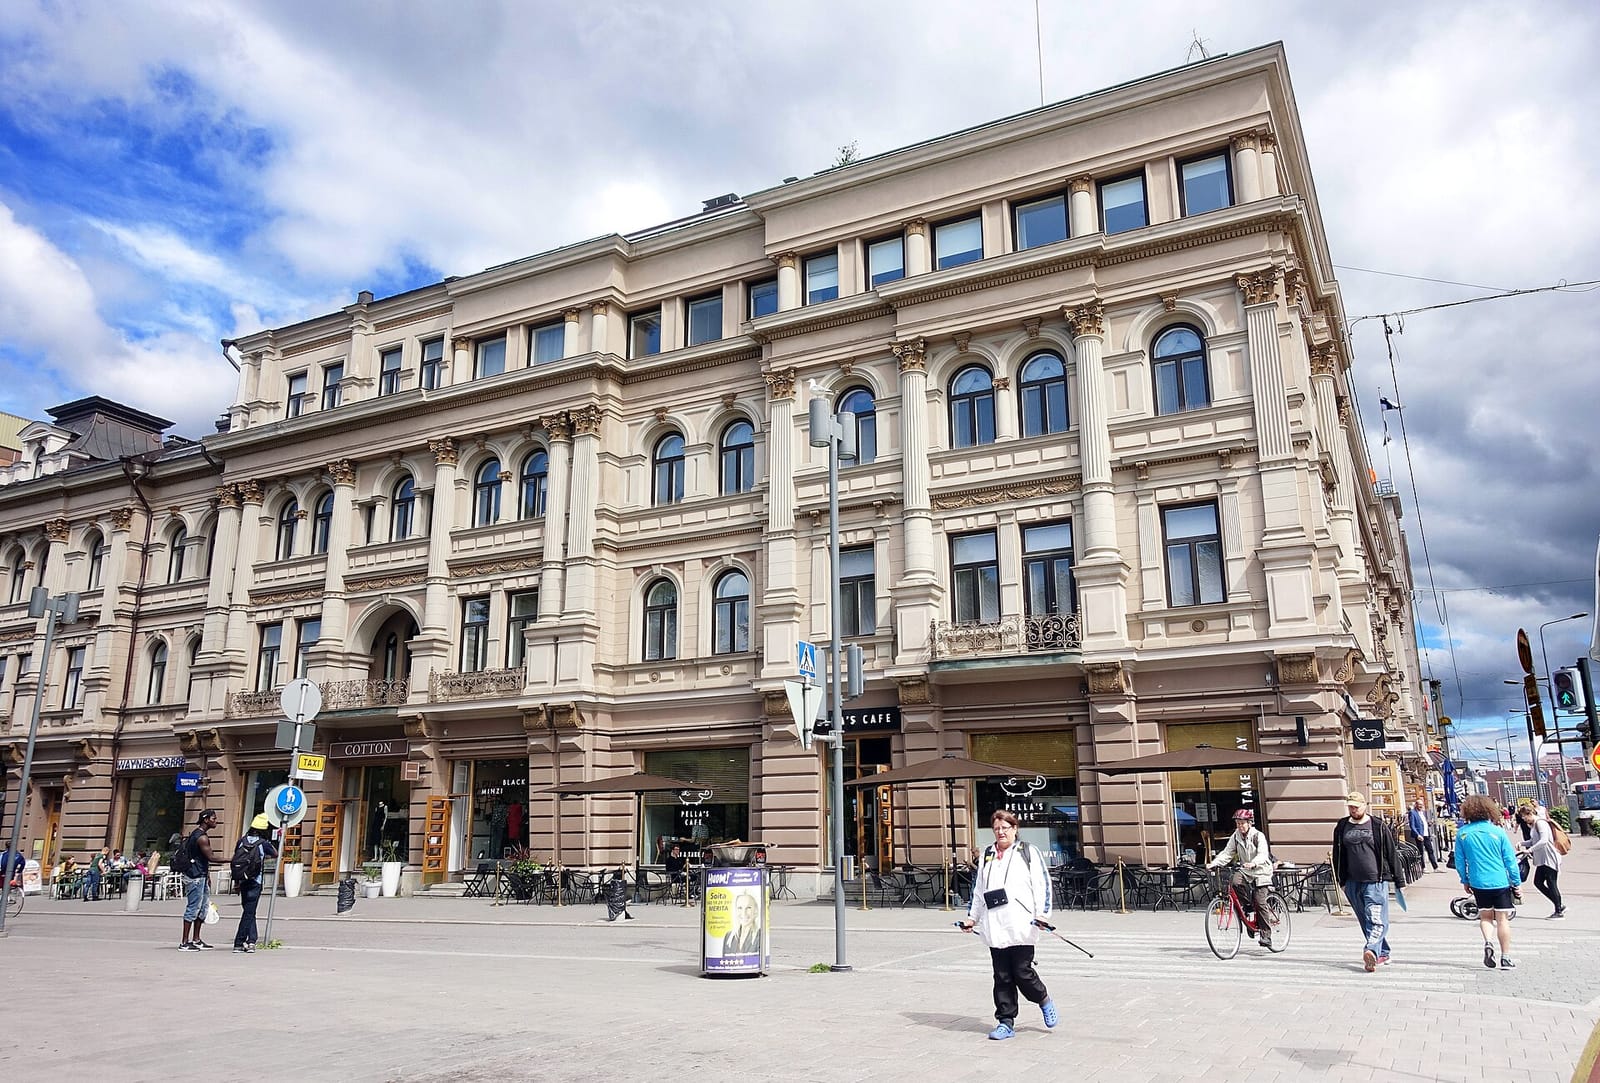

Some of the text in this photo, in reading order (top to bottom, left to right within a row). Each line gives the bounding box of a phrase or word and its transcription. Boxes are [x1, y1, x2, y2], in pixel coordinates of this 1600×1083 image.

[863, 713, 891, 724] CAFE
[1236, 736, 1248, 751] AY
[345, 742, 392, 755] COTTON
[303, 758, 320, 767] TAXI
[502, 778, 526, 786] BLACK
[1240, 774, 1253, 804] TAKE
[1005, 802, 1044, 811] PELLA'S
[680, 810, 709, 818] PELLA'S
[684, 818, 702, 826] CAFE
[710, 892, 727, 900] Soita
